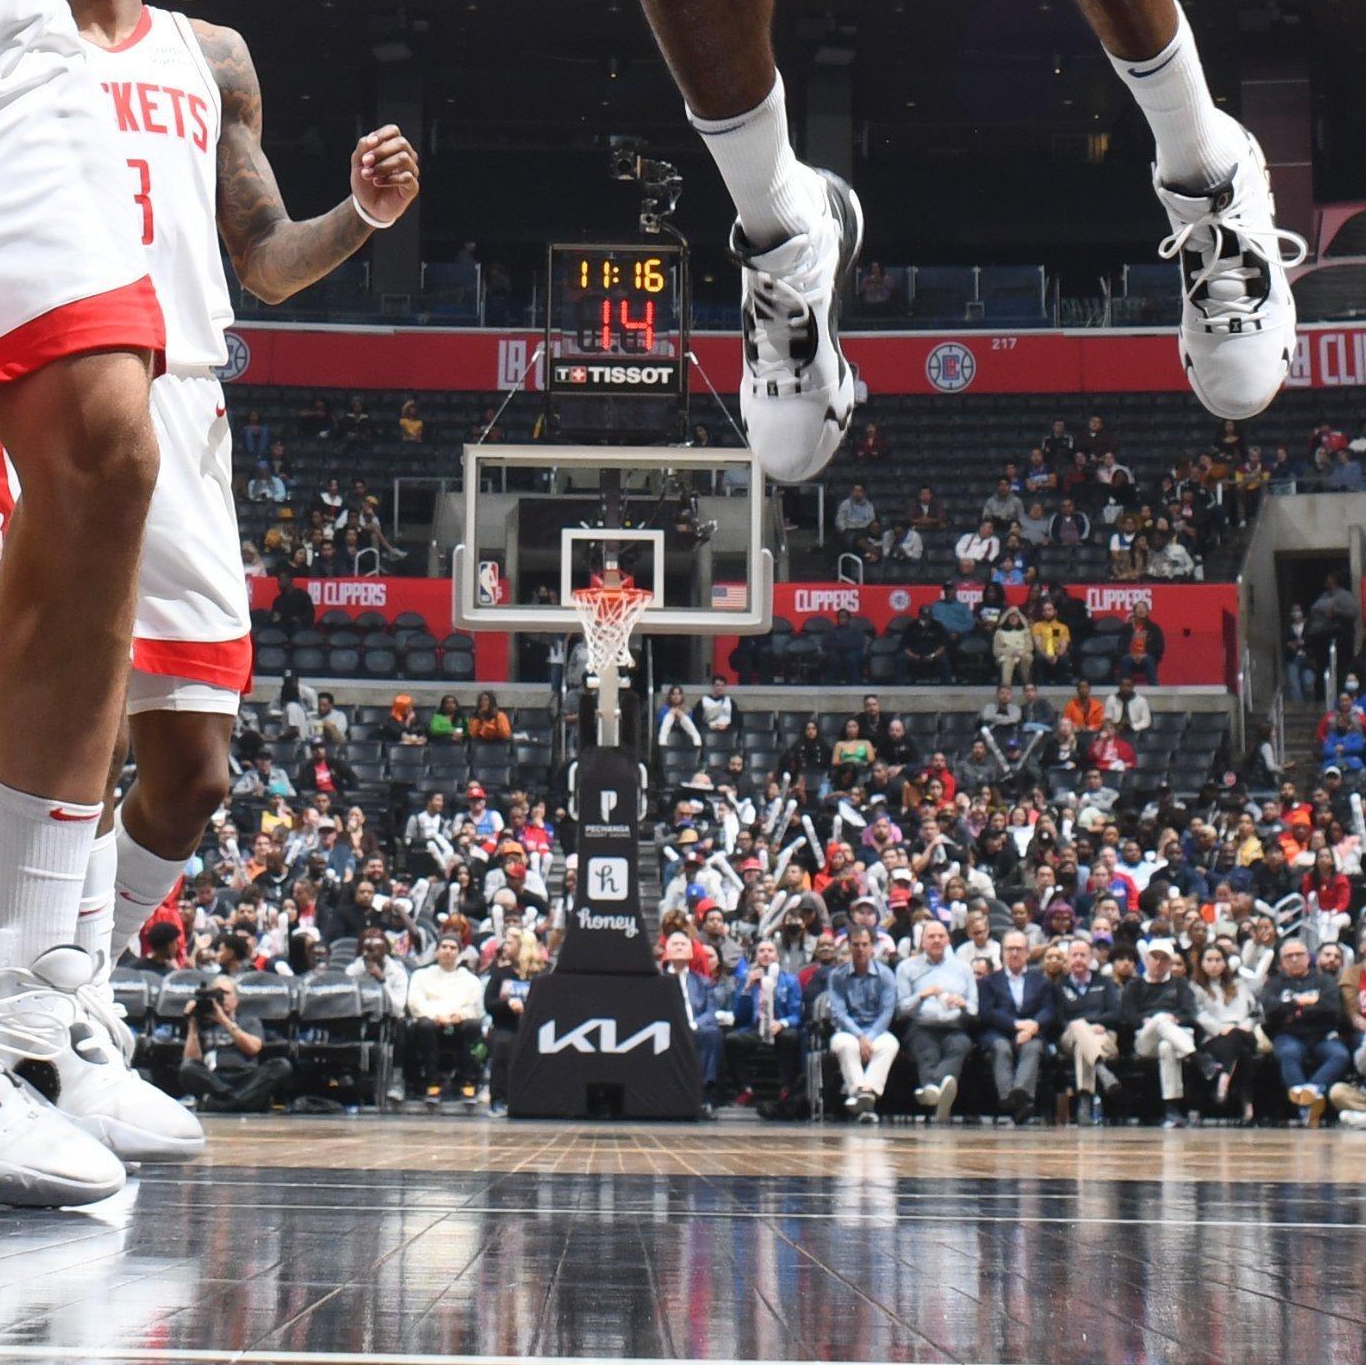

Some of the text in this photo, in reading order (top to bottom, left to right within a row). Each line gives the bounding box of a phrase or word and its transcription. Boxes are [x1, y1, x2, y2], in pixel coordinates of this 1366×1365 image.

[100, 81, 208, 154] KETS
[580, 258, 665, 293] 11:16
[600, 298, 655, 351] 14
[991, 337, 1018, 351] 217
[588, 366, 674, 385] TISSOT
[324, 582, 387, 606] CLIPPERS
[794, 588, 859, 613] CLIPPERS
[1088, 588, 1152, 612] CLIPPERS
[577, 907, 639, 939] honey
[538, 1018, 671, 1056] KIA
